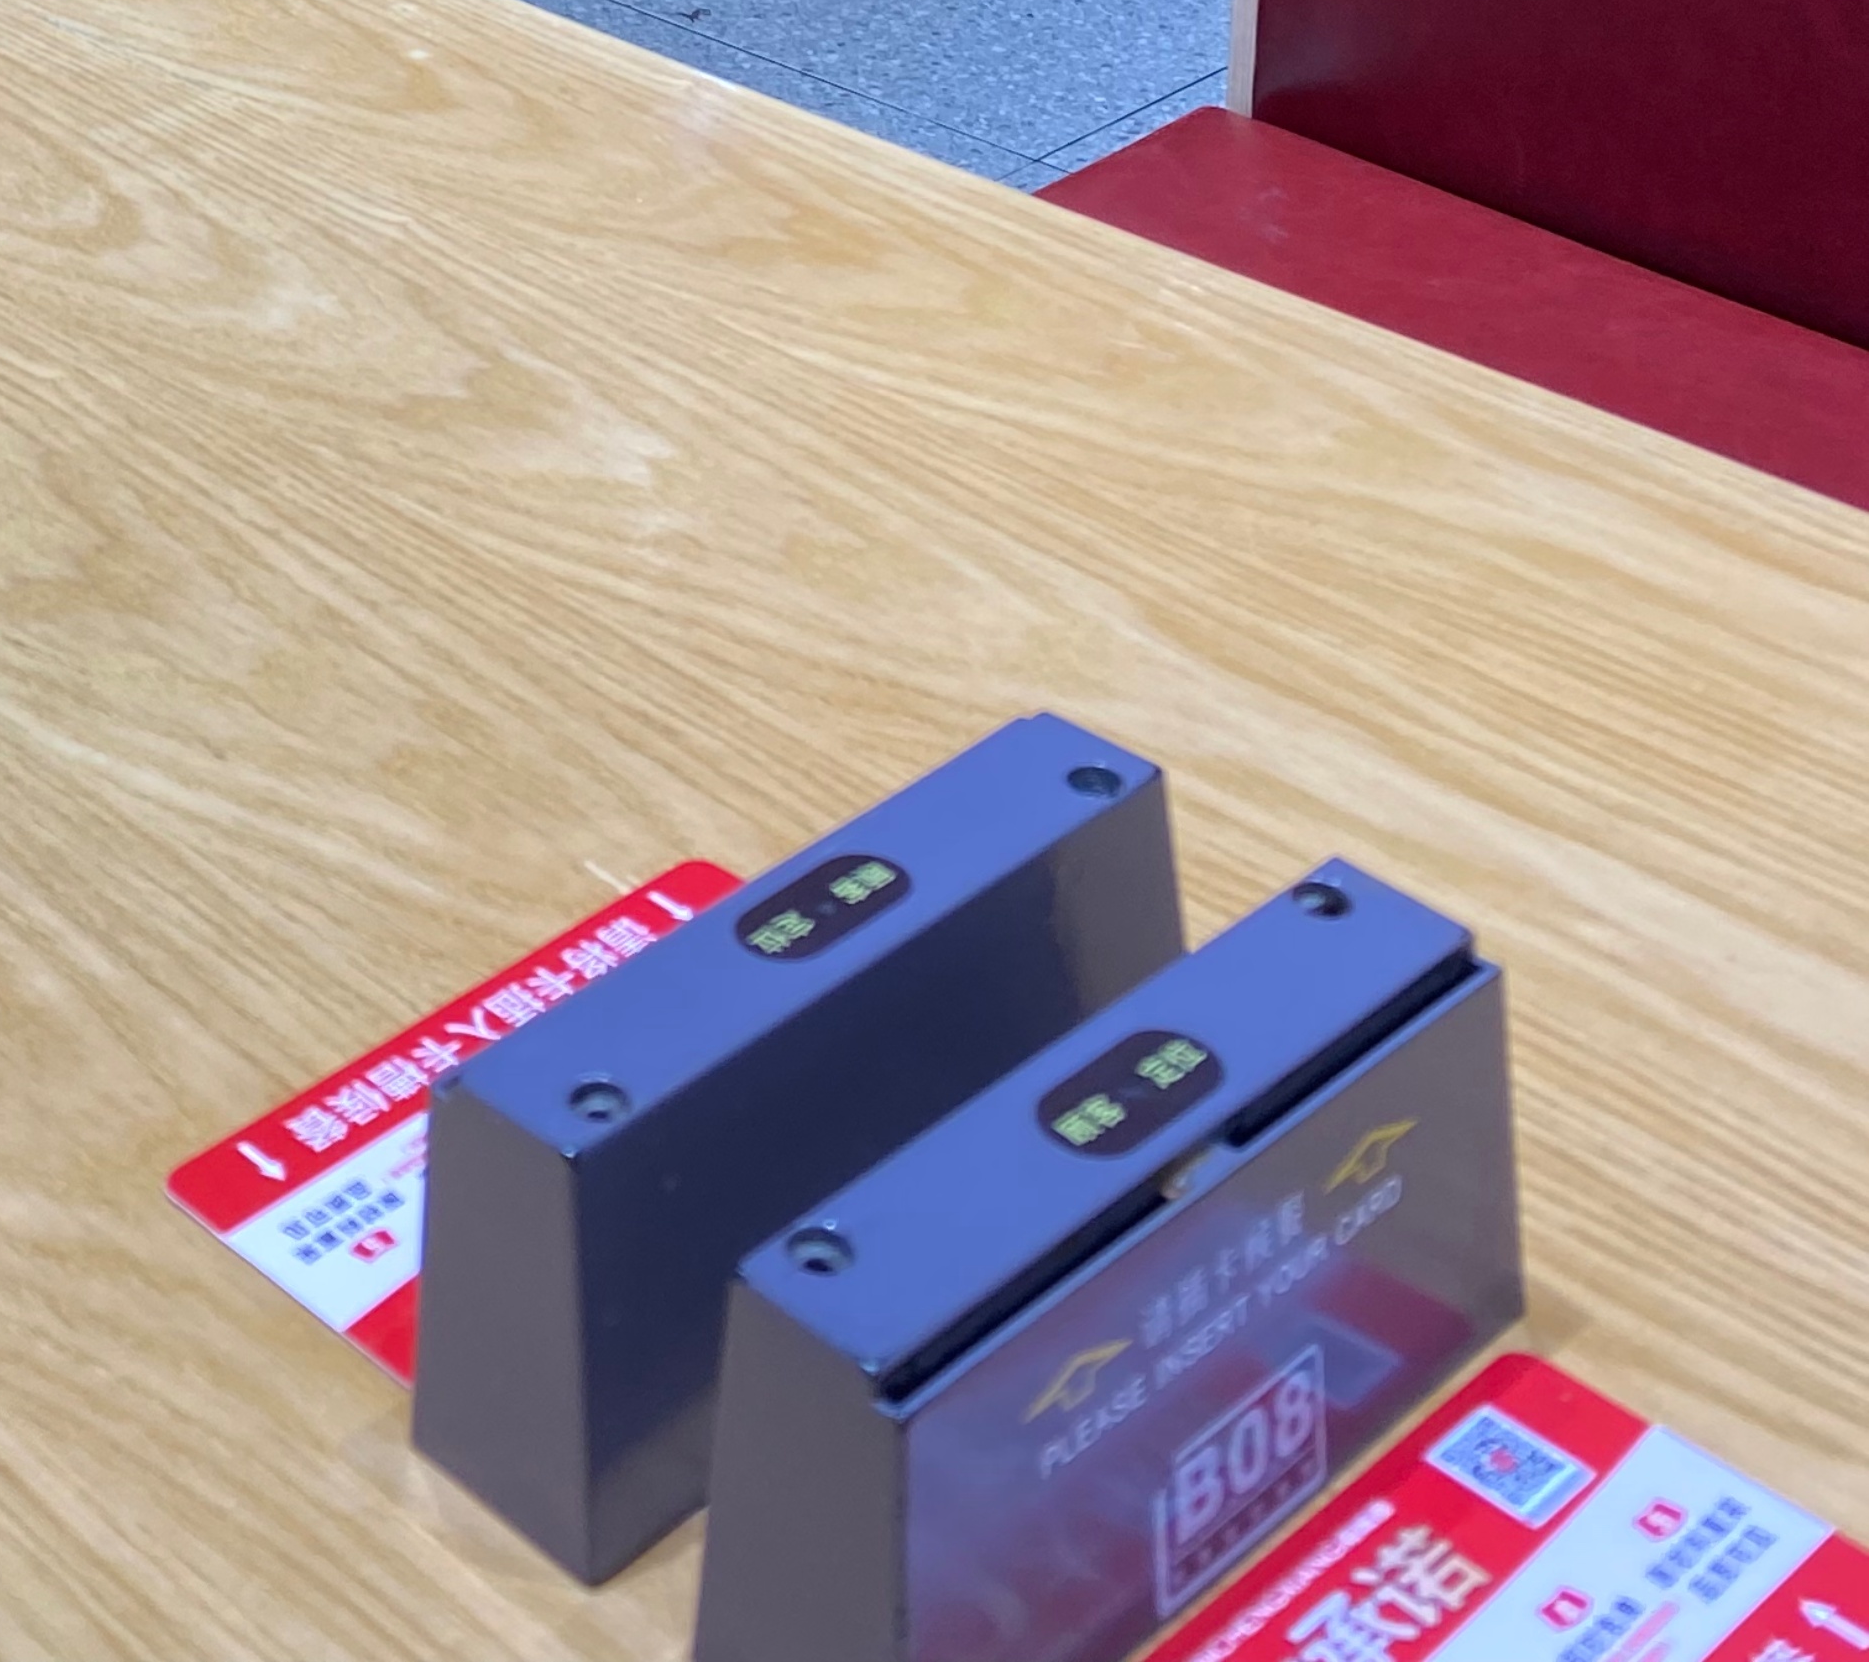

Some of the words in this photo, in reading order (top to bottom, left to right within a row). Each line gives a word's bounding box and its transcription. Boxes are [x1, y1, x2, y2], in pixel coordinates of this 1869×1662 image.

[285, 915, 659, 1153] 请将卡插入卡槽候餐
[1038, 1374, 1148, 1480] PLEASE
[1153, 1294, 1251, 1391] INSERT
[1256, 1234, 1329, 1307] YOUR
[1333, 1174, 1403, 1248] CARD
[1174, 1369, 1314, 1547] B08
